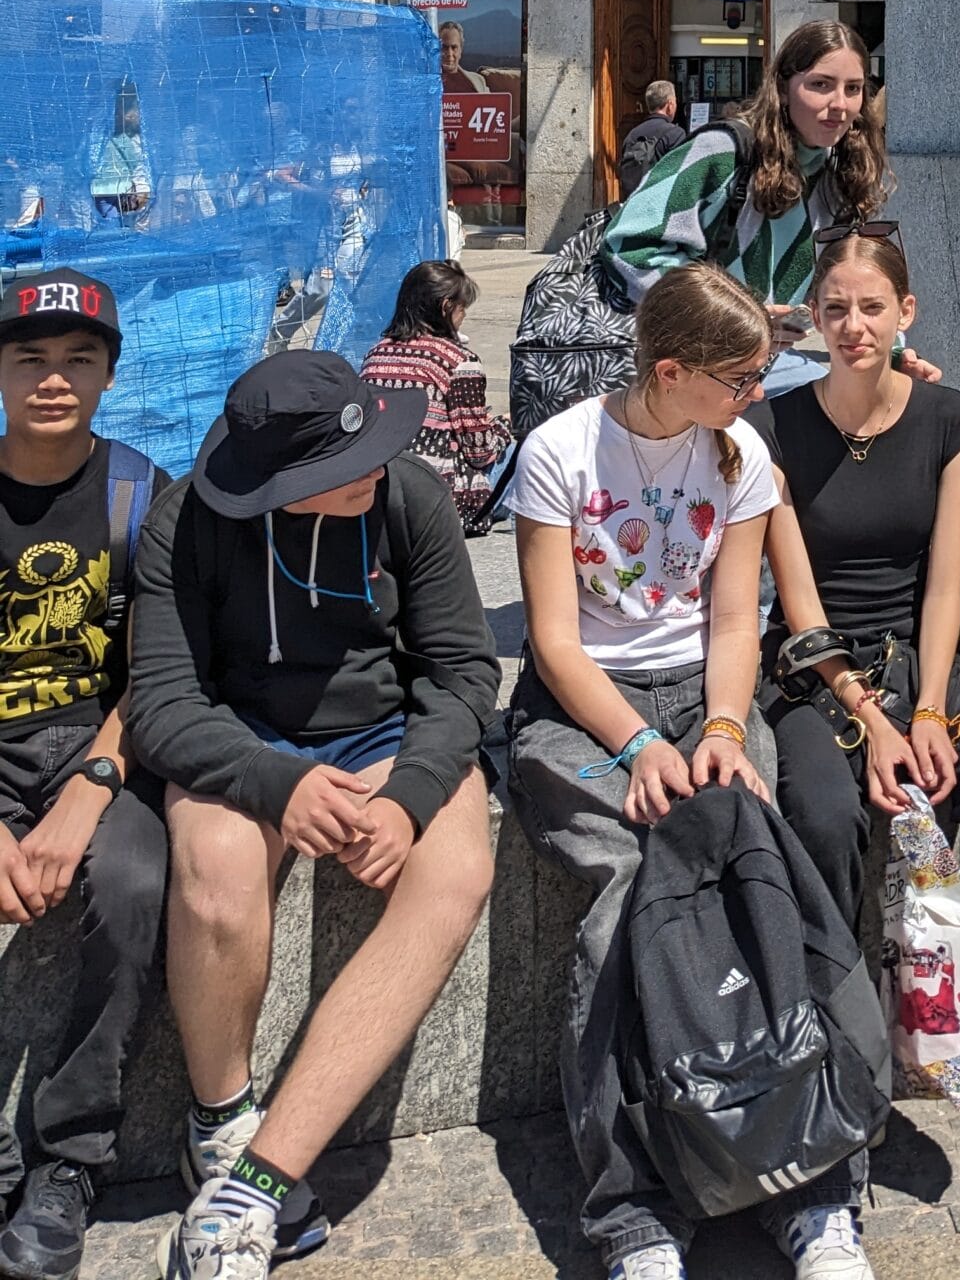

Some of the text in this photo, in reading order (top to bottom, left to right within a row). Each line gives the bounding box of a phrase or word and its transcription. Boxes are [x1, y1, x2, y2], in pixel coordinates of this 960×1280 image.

[443, 102, 460, 110] Móvil
[443, 110, 463, 118] itadas
[448, 131, 459, 140] TV
[18, 282, 102, 317] PERÚ
[718, 976, 750, 996] adidas
